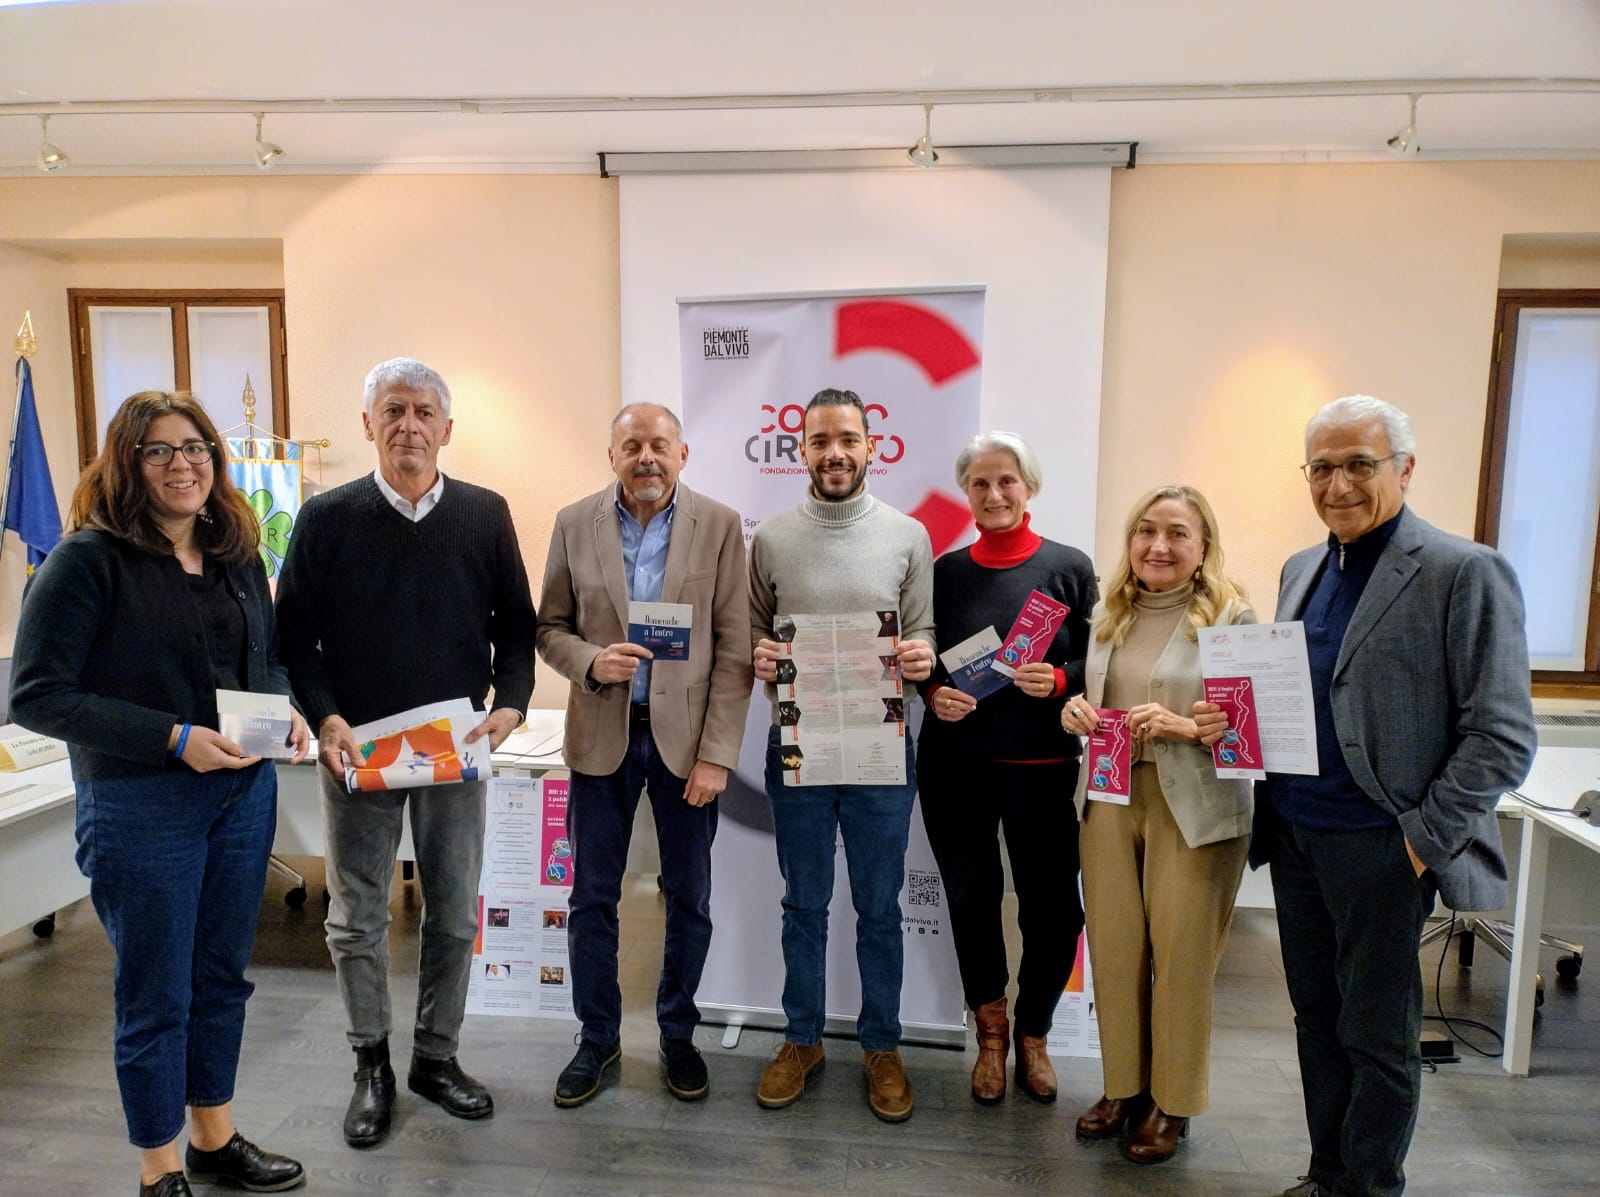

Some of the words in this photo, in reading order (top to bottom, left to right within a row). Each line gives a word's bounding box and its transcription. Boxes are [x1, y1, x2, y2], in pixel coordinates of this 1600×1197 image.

[704, 330, 749, 344] PIEMONTE
[704, 344, 724, 357] DAL
[725, 343, 749, 356] VIVO
[759, 467, 809, 475] FONDAZIONE
[267, 528, 278, 542] R
[904, 917, 938, 926] dalvivo.it
